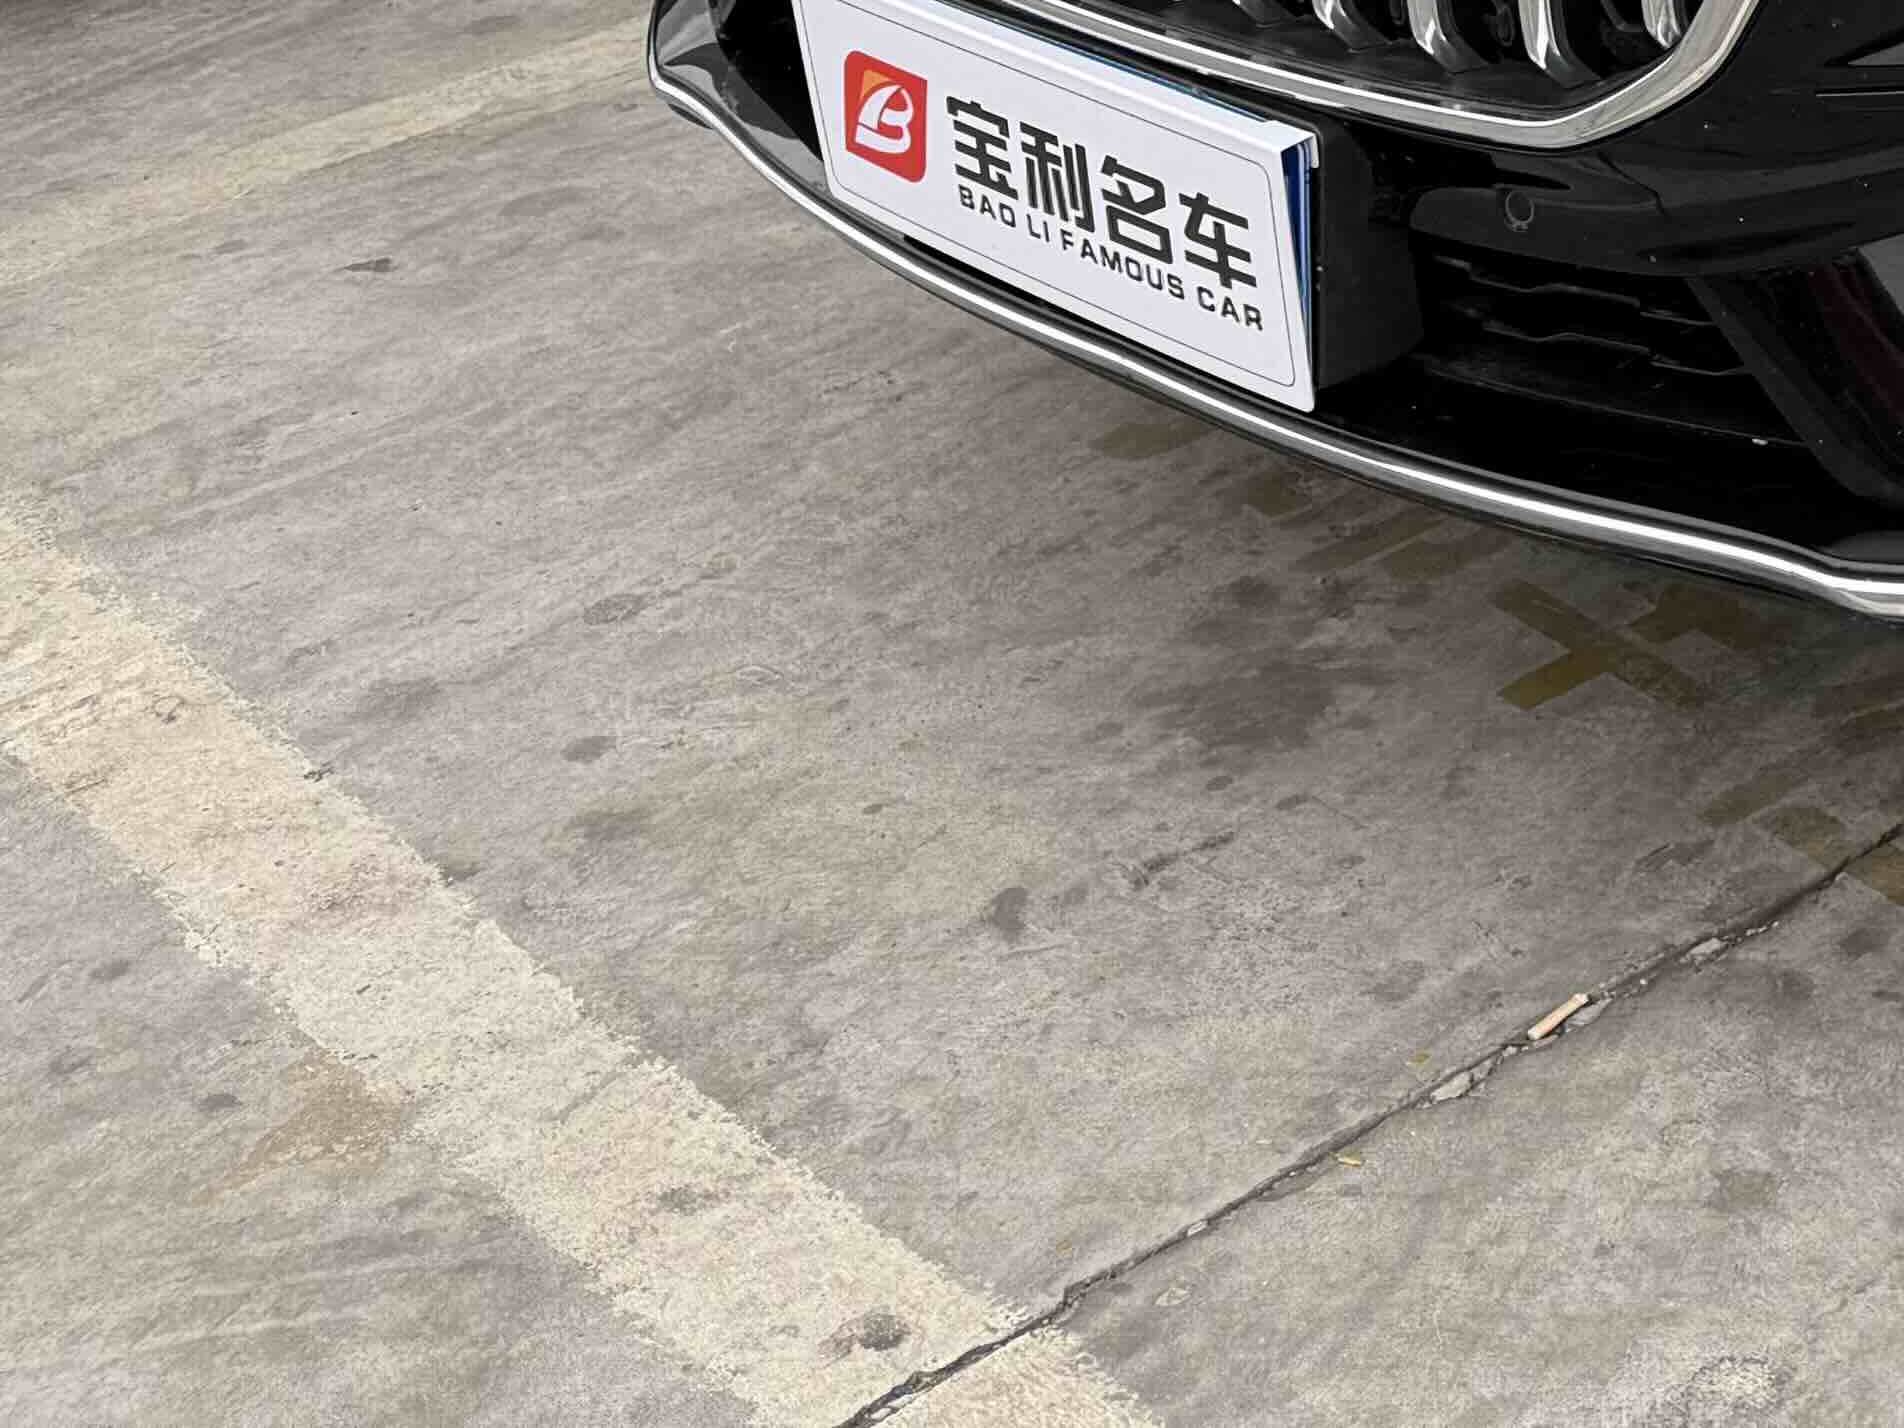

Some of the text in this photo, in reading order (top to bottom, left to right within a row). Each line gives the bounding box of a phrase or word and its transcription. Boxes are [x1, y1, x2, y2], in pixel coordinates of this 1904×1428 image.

[946, 94, 1257, 290] 宝利名车
[959, 187, 1264, 333] BAO LI FAMOUS CAR
